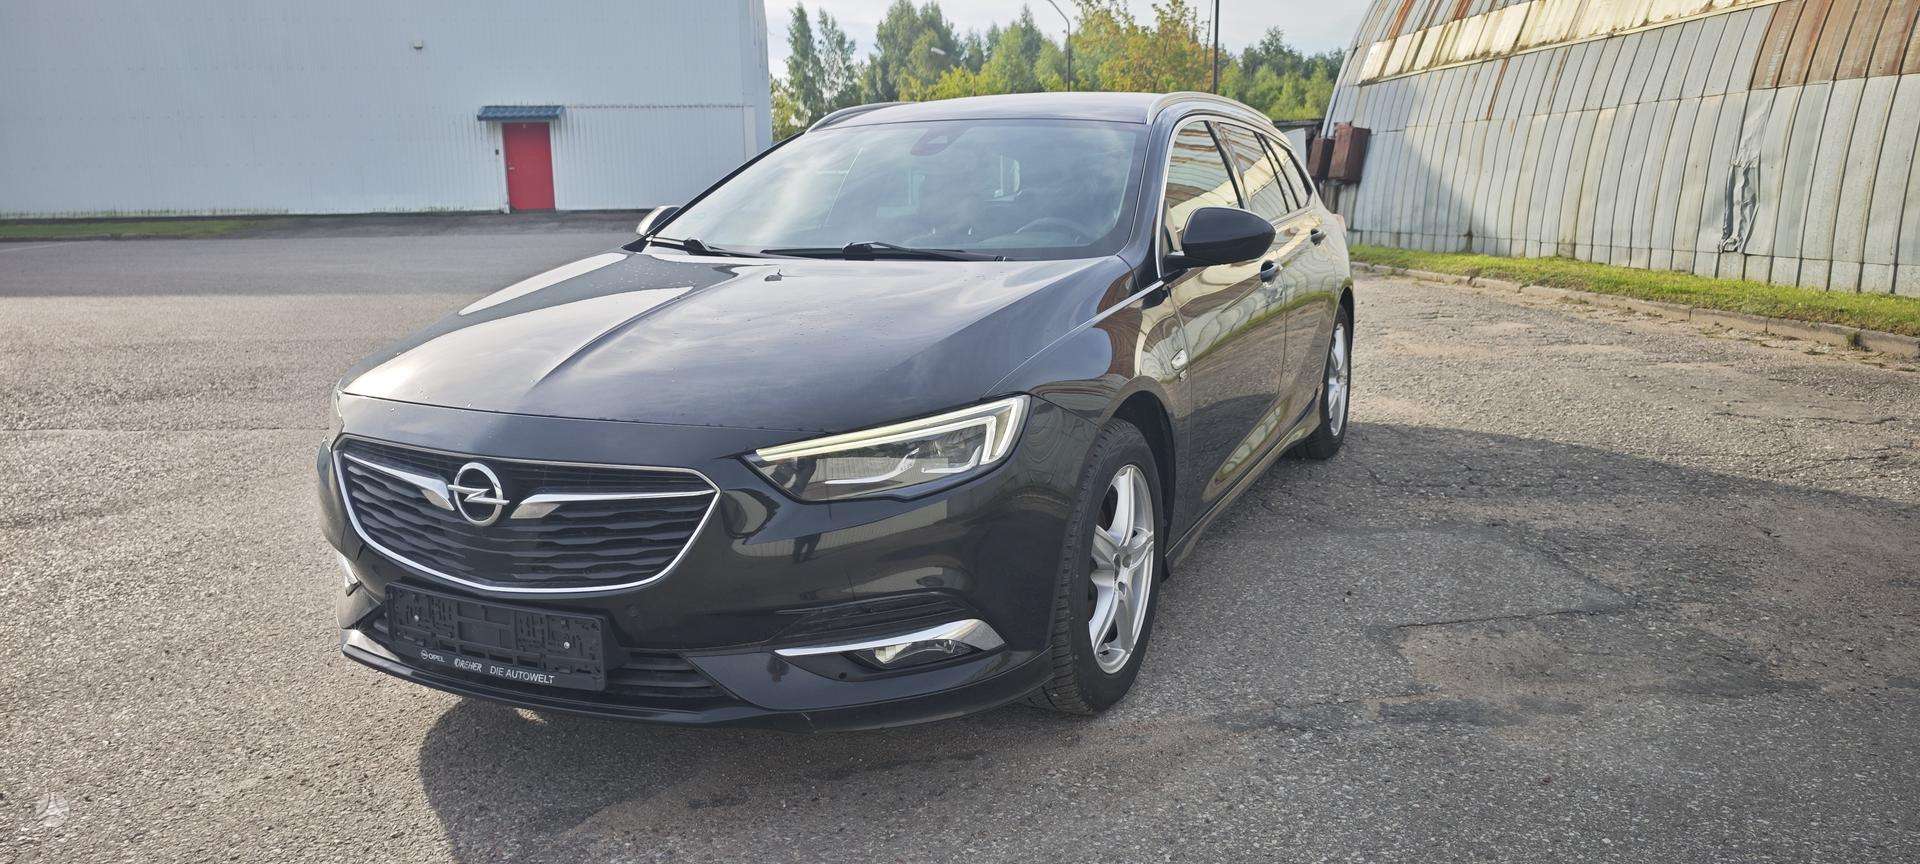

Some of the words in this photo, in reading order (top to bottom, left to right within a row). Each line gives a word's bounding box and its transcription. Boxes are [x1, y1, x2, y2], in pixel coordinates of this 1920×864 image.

[428, 653, 446, 663] OPEL
[454, 658, 483, 673] DREHER
[490, 665, 504, 677] DIE
[505, 669, 556, 684] AUTOWELT
